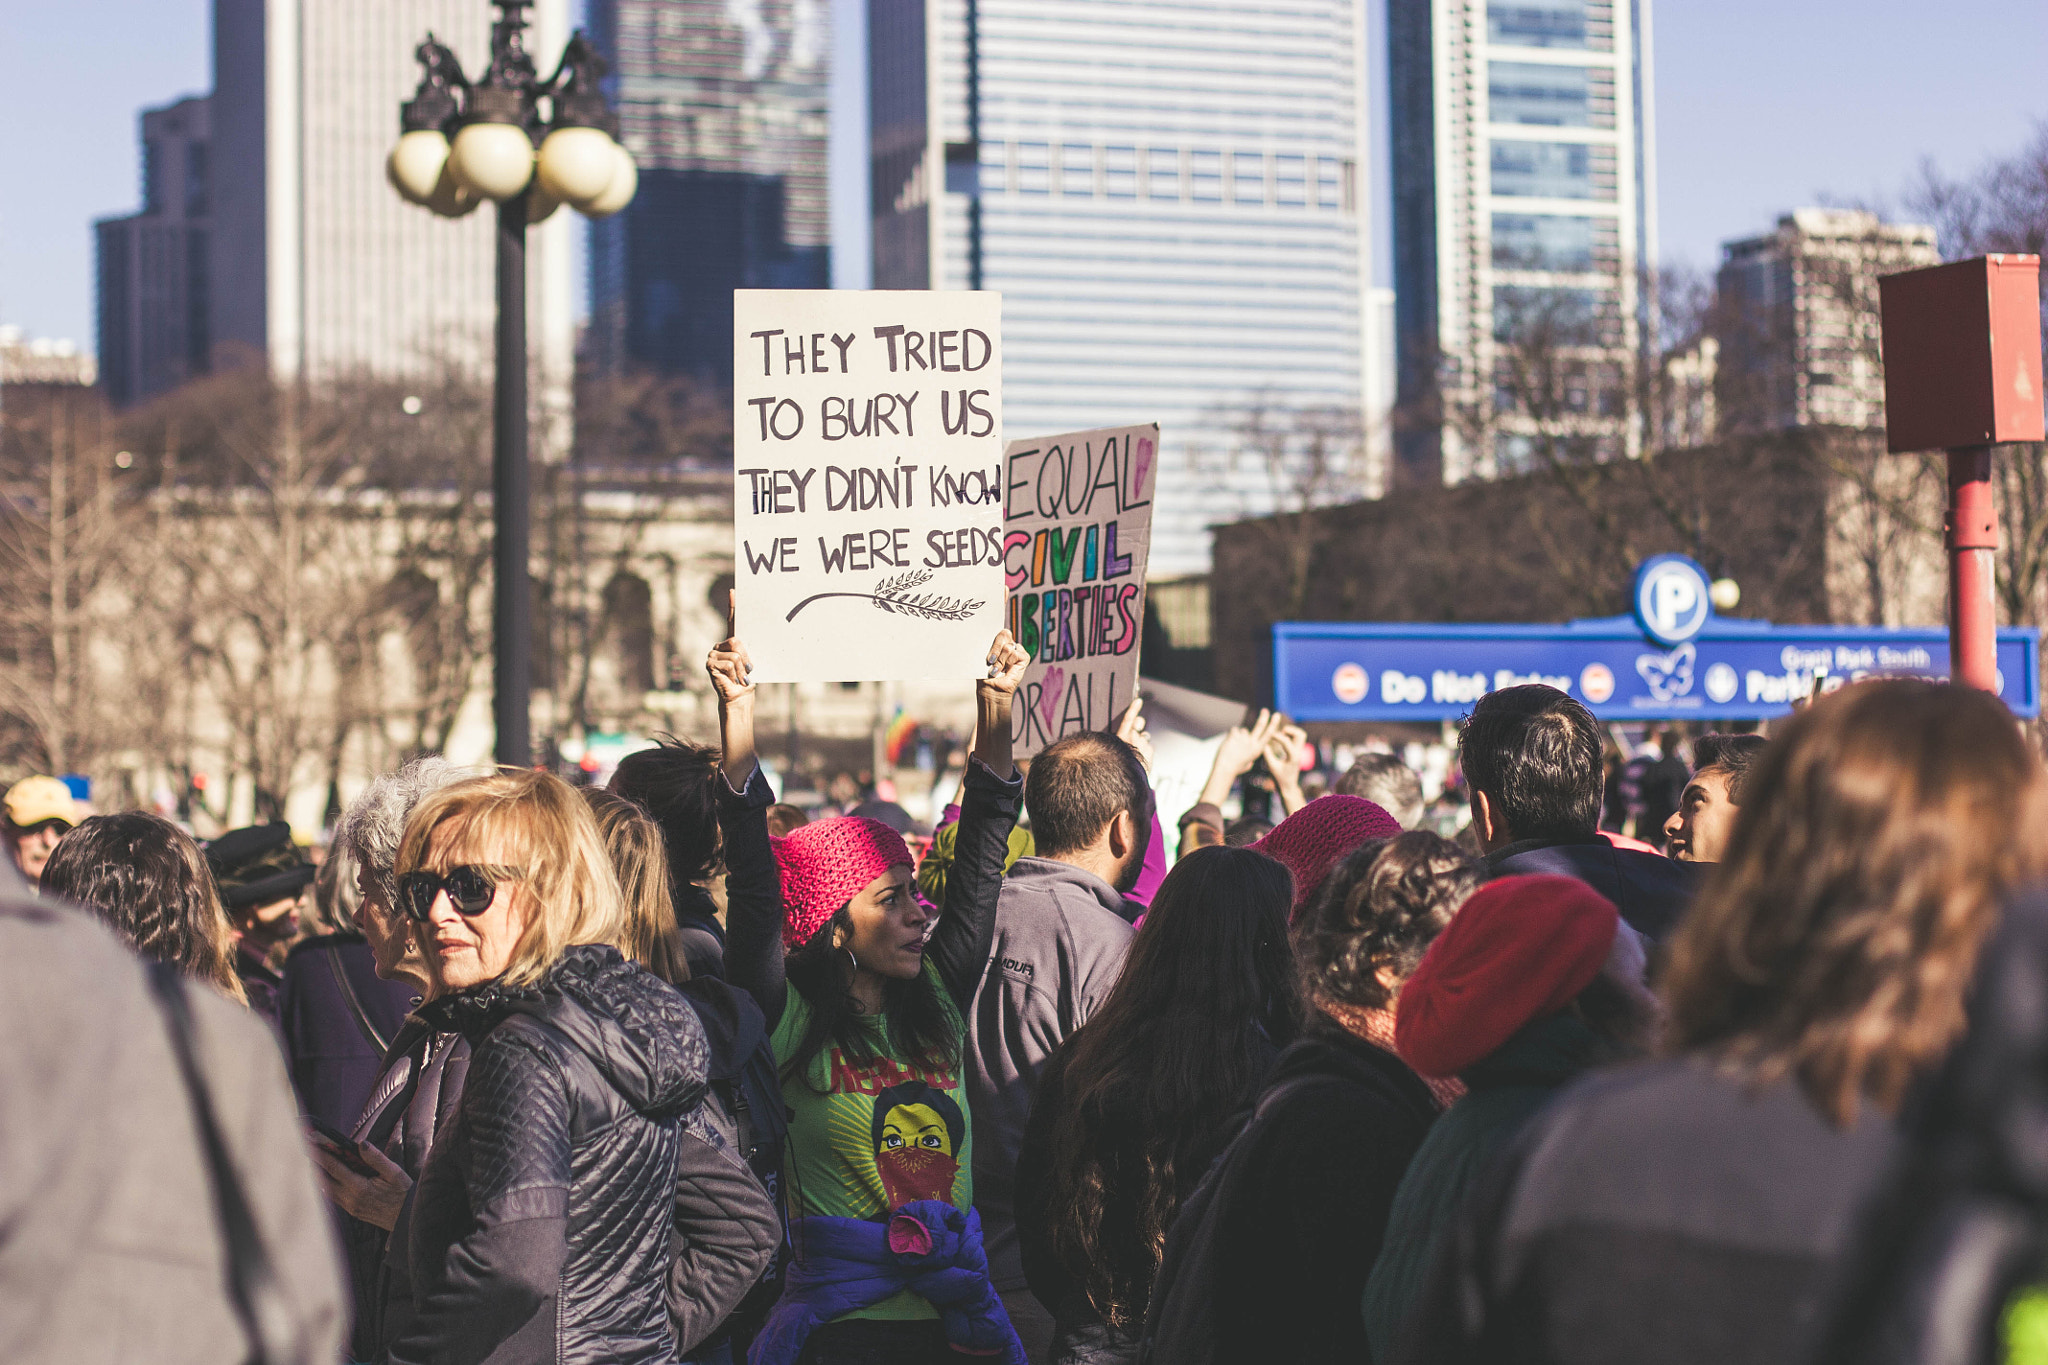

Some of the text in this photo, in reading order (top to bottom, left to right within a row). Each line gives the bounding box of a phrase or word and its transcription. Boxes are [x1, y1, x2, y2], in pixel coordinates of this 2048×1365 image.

[750, 325, 992, 376] THEY TRIED
[747, 396, 804, 442] TO
[821, 390, 919, 441] BURY
[738, 456, 1001, 515] THEY DIDN'T KNOW
[1005, 433, 1151, 521] EQUAL
[743, 526, 1004, 575] WE WERE SEEDS
[1002, 519, 1132, 592] CIVIL
[1009, 582, 1139, 665] IBERTIES
[1655, 574, 1698, 632] P
[1011, 681, 1048, 749] OR
[1381, 669, 1428, 704] Do
[1432, 669, 1487, 704] Not
